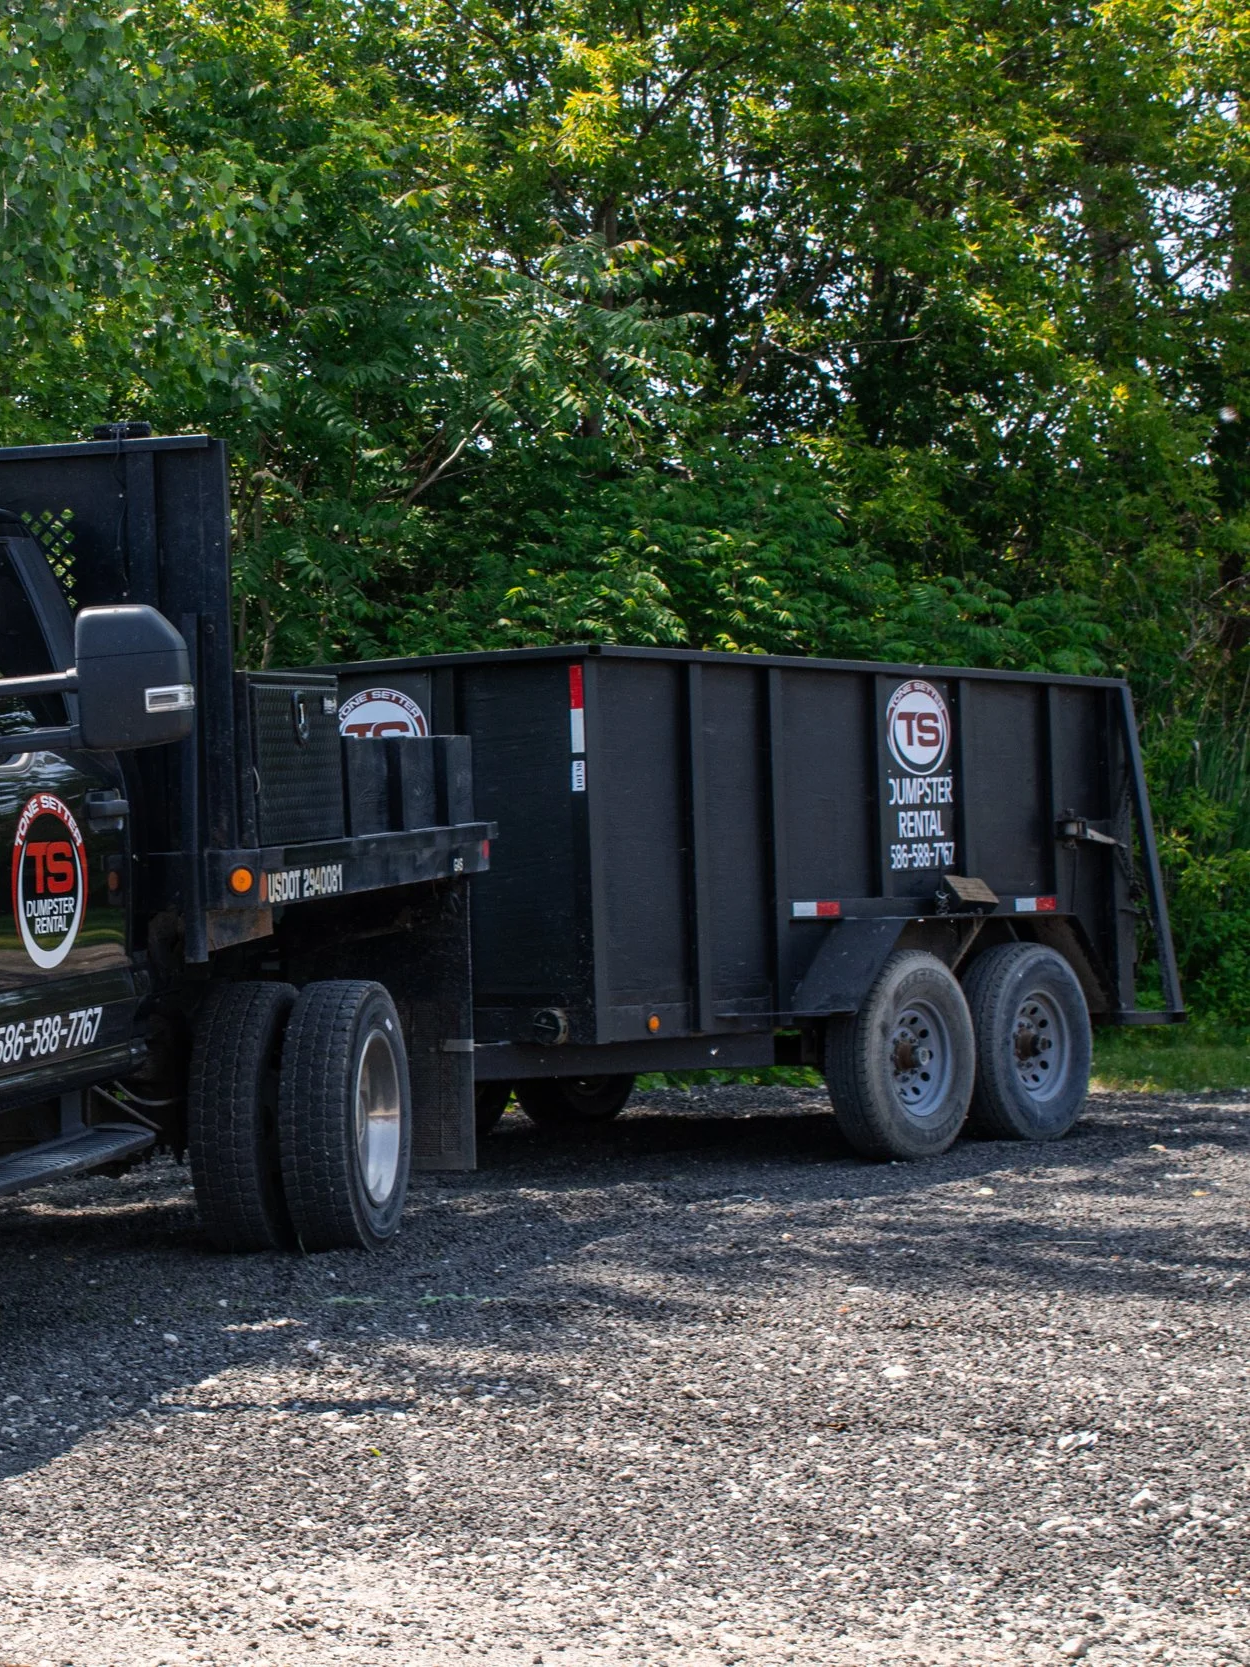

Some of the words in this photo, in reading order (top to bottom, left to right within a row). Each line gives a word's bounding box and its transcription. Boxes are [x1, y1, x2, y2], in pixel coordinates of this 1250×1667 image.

[338, 693, 369, 721] TONE
[371, 690, 421, 718] SETTER
[897, 711, 941, 748] TS
[888, 776, 954, 805] DUMPSTER
[14, 798, 40, 847] TONE
[40, 795, 83, 847] SETTER
[898, 810, 945, 838] RENTAL
[26, 841, 75, 894] TS
[268, 869, 301, 903] USDOT
[26, 897, 75, 918] DUMPSTER
[34, 916, 69, 935] RENTAL
